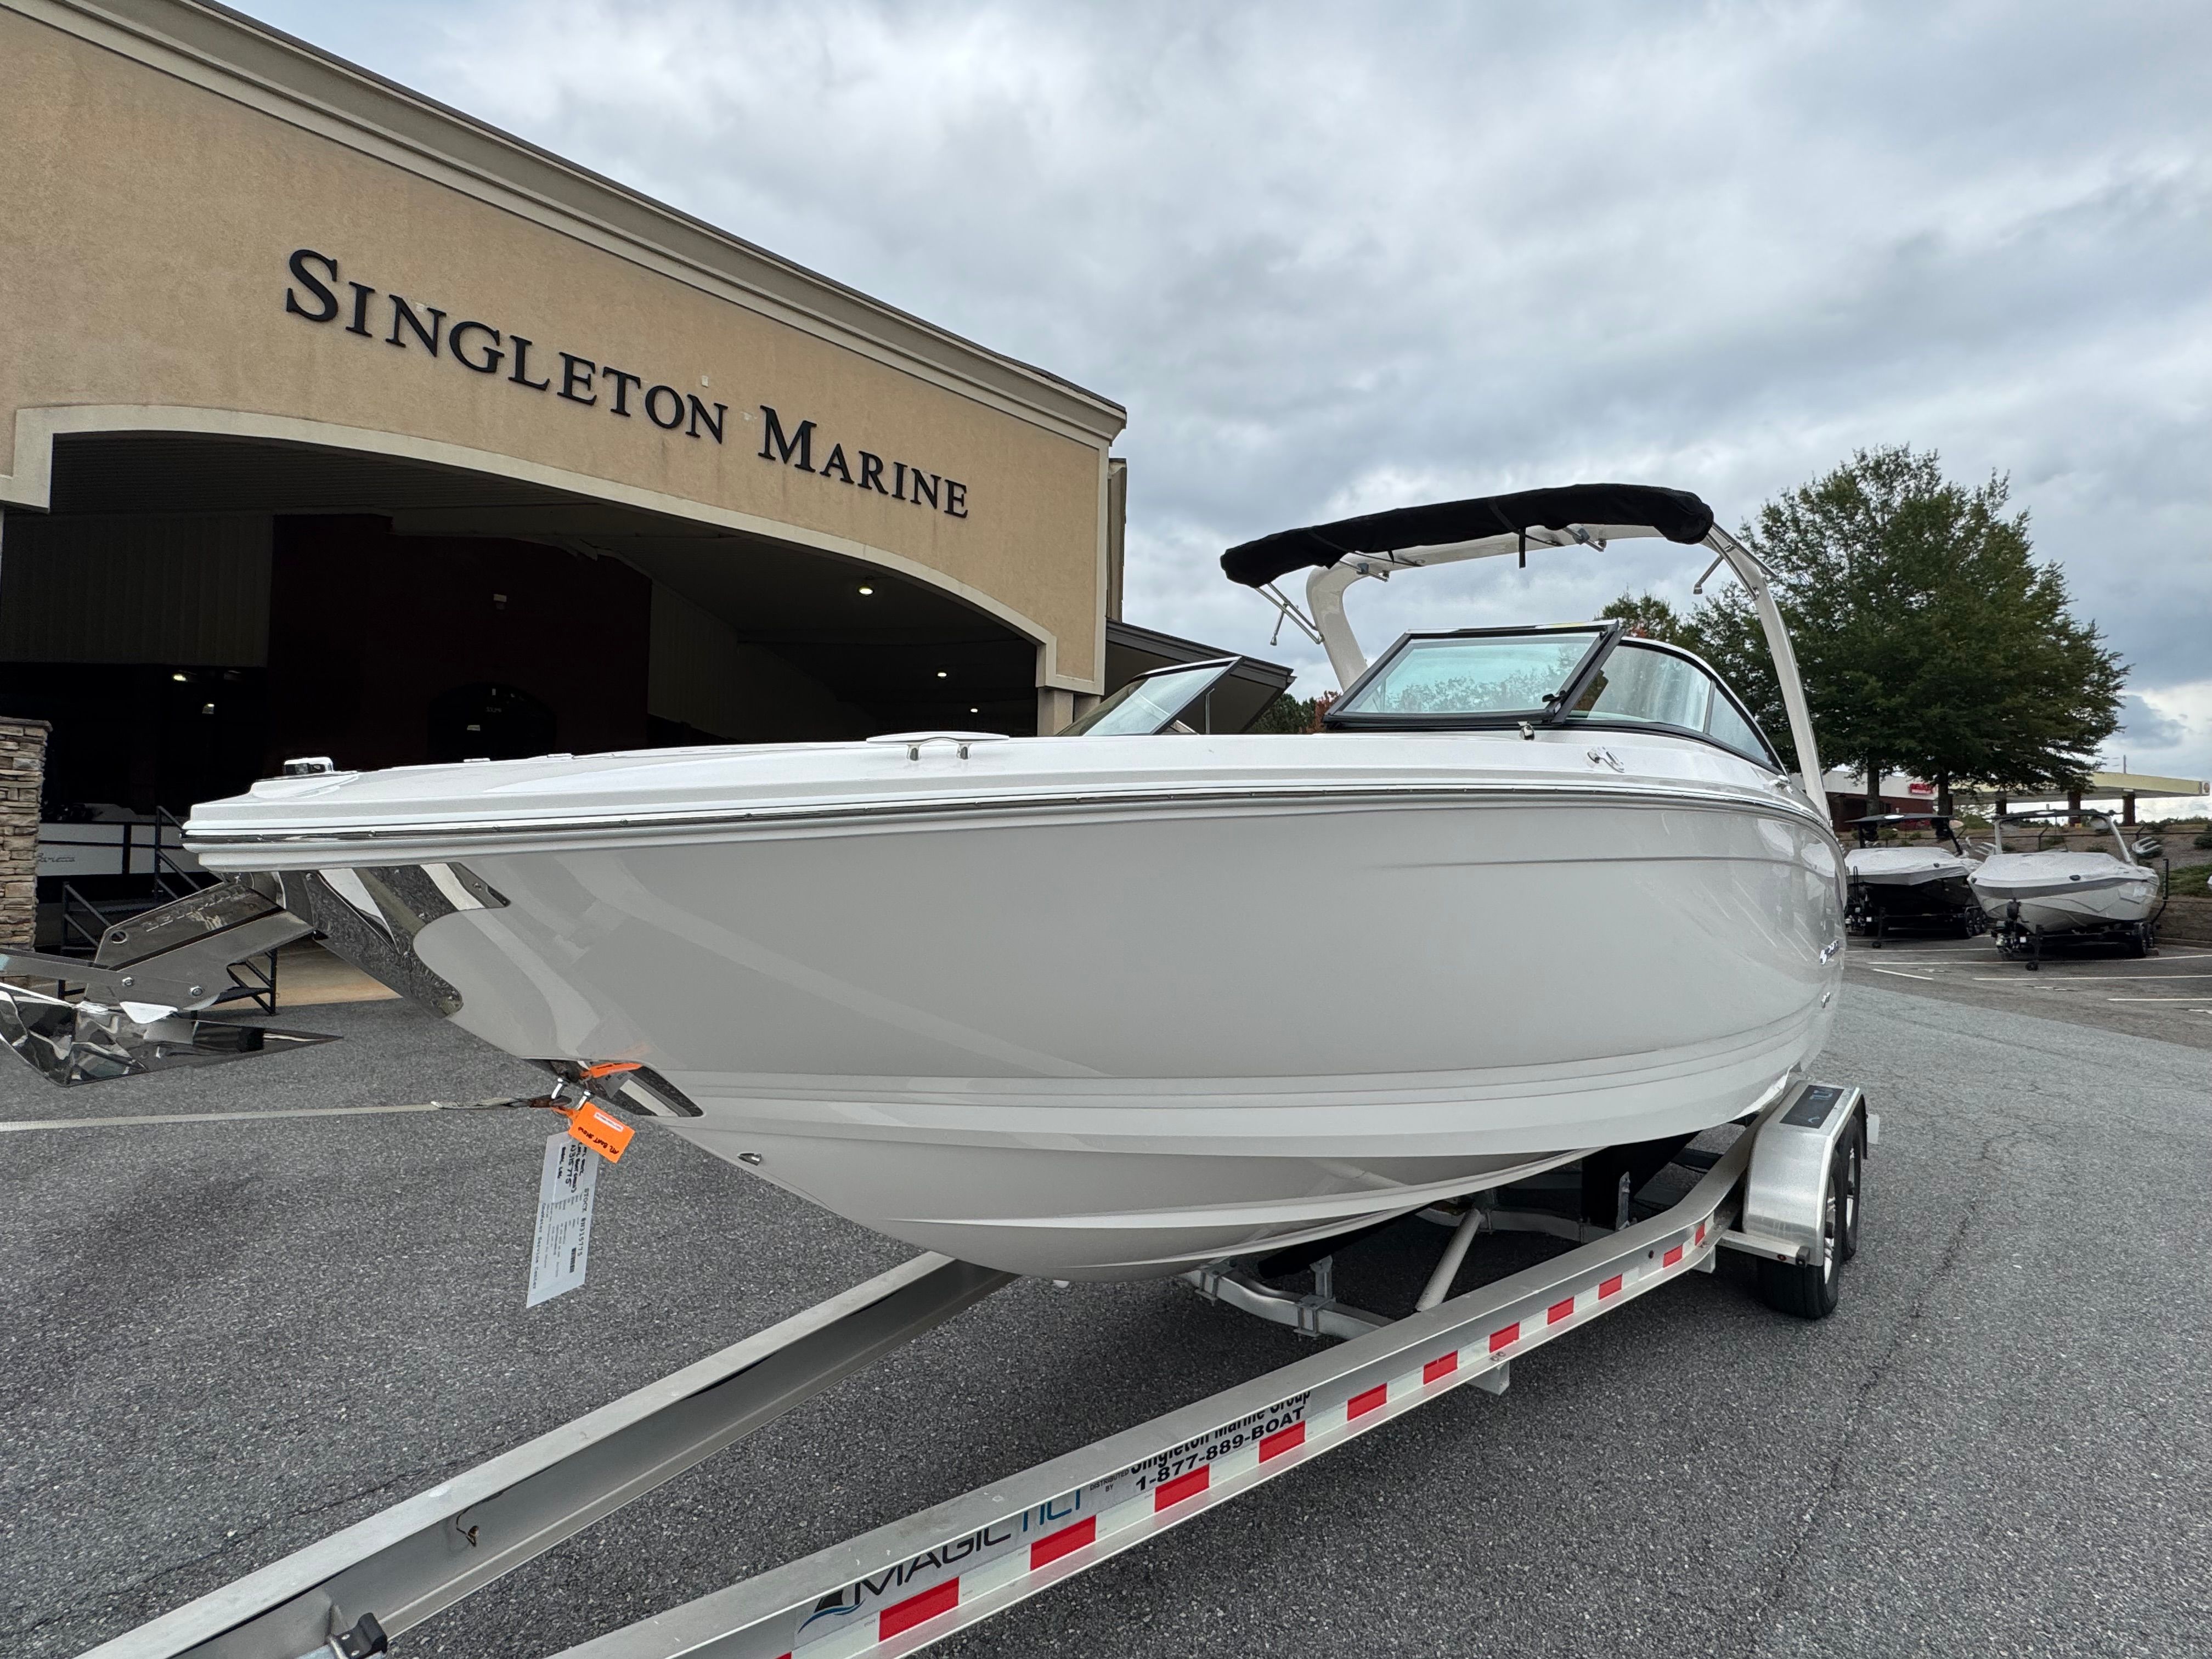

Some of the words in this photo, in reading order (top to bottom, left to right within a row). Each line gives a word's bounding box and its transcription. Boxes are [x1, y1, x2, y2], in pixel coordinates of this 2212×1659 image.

[286, 249, 729, 444] SINGLETON
[757, 405, 968, 518] MARINE
[1136, 1406, 1305, 1491] 1-877-889-BOAT
[1090, 1468, 1129, 1491] DISTRIBUTED
[1105, 1483, 1114, 1492] BY
